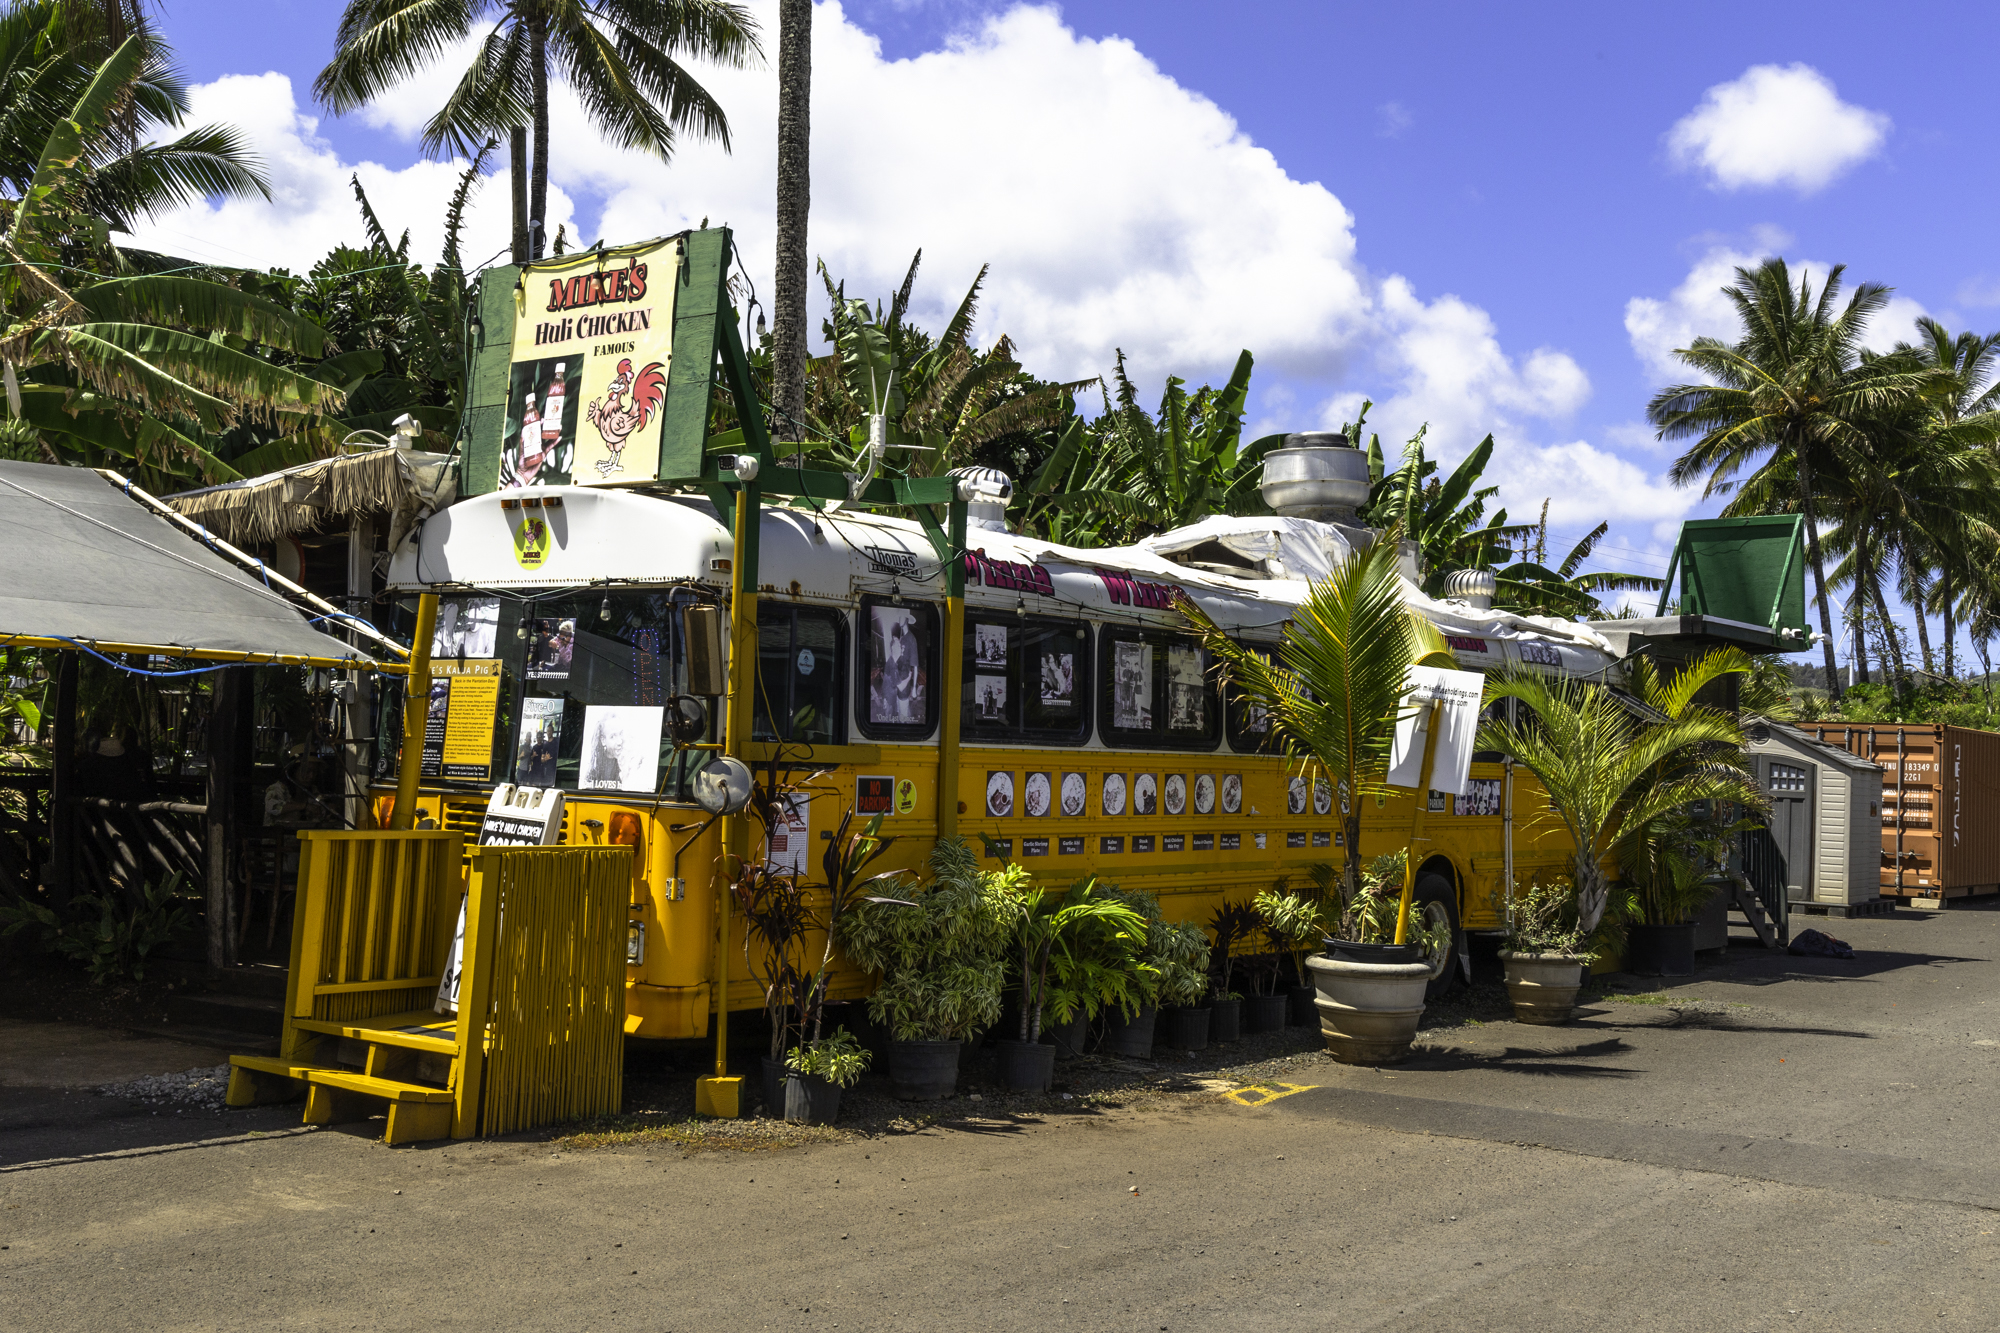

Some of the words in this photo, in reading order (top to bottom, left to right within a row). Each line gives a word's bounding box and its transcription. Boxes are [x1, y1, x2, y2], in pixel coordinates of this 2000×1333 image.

[546, 257, 648, 312] MIKE'S
[534, 318, 573, 346] Huli
[576, 308, 653, 339] CHICKEN
[594, 341, 635, 356] FAMOUS
[864, 545, 918, 568] Thomas
[1905, 763, 1930, 772] 183349
[595, 780, 616, 788] LOVES
[1904, 773, 1920, 782] 22G1
[870, 781, 881, 795] NO
[859, 796, 890, 811] PARKING
[1430, 798, 1444, 808] PARKING
[484, 820, 504, 832] MIKE'S
[517, 824, 542, 838] CHICKEN
